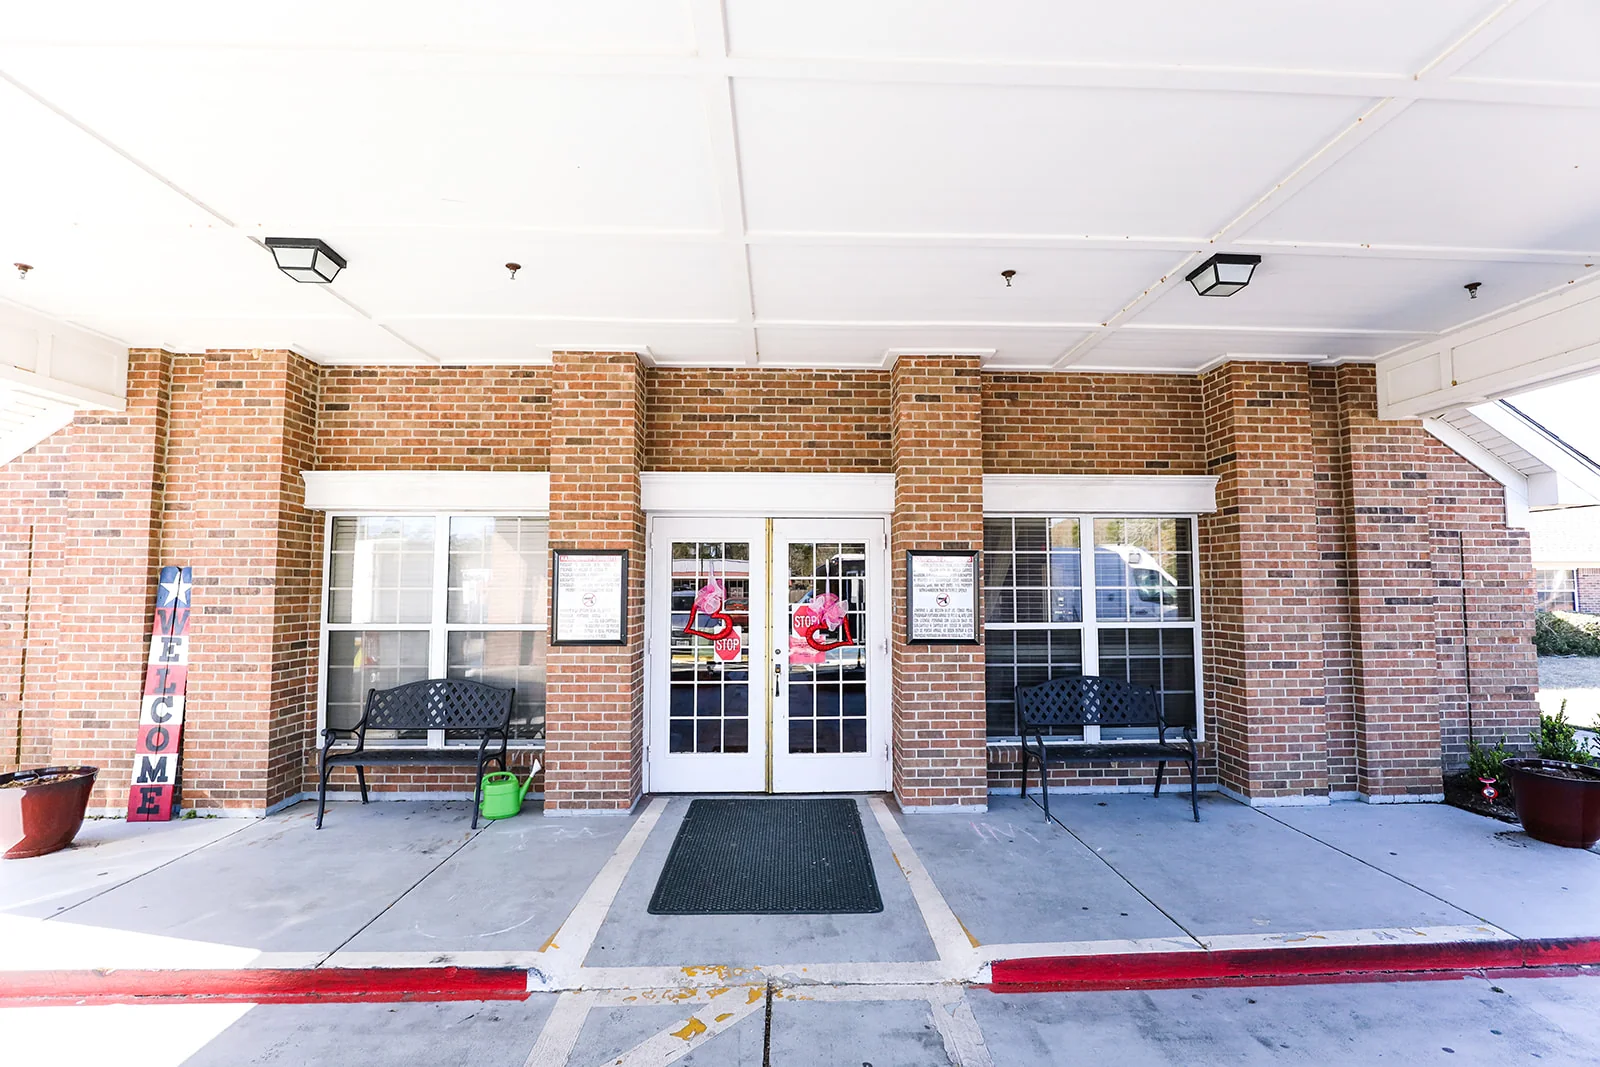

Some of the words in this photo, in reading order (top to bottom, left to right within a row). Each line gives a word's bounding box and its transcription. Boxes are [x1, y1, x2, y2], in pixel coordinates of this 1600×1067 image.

[794, 615, 817, 628] STOP
[716, 638, 739, 651] STOP
[136, 609, 190, 815] WELCOME
